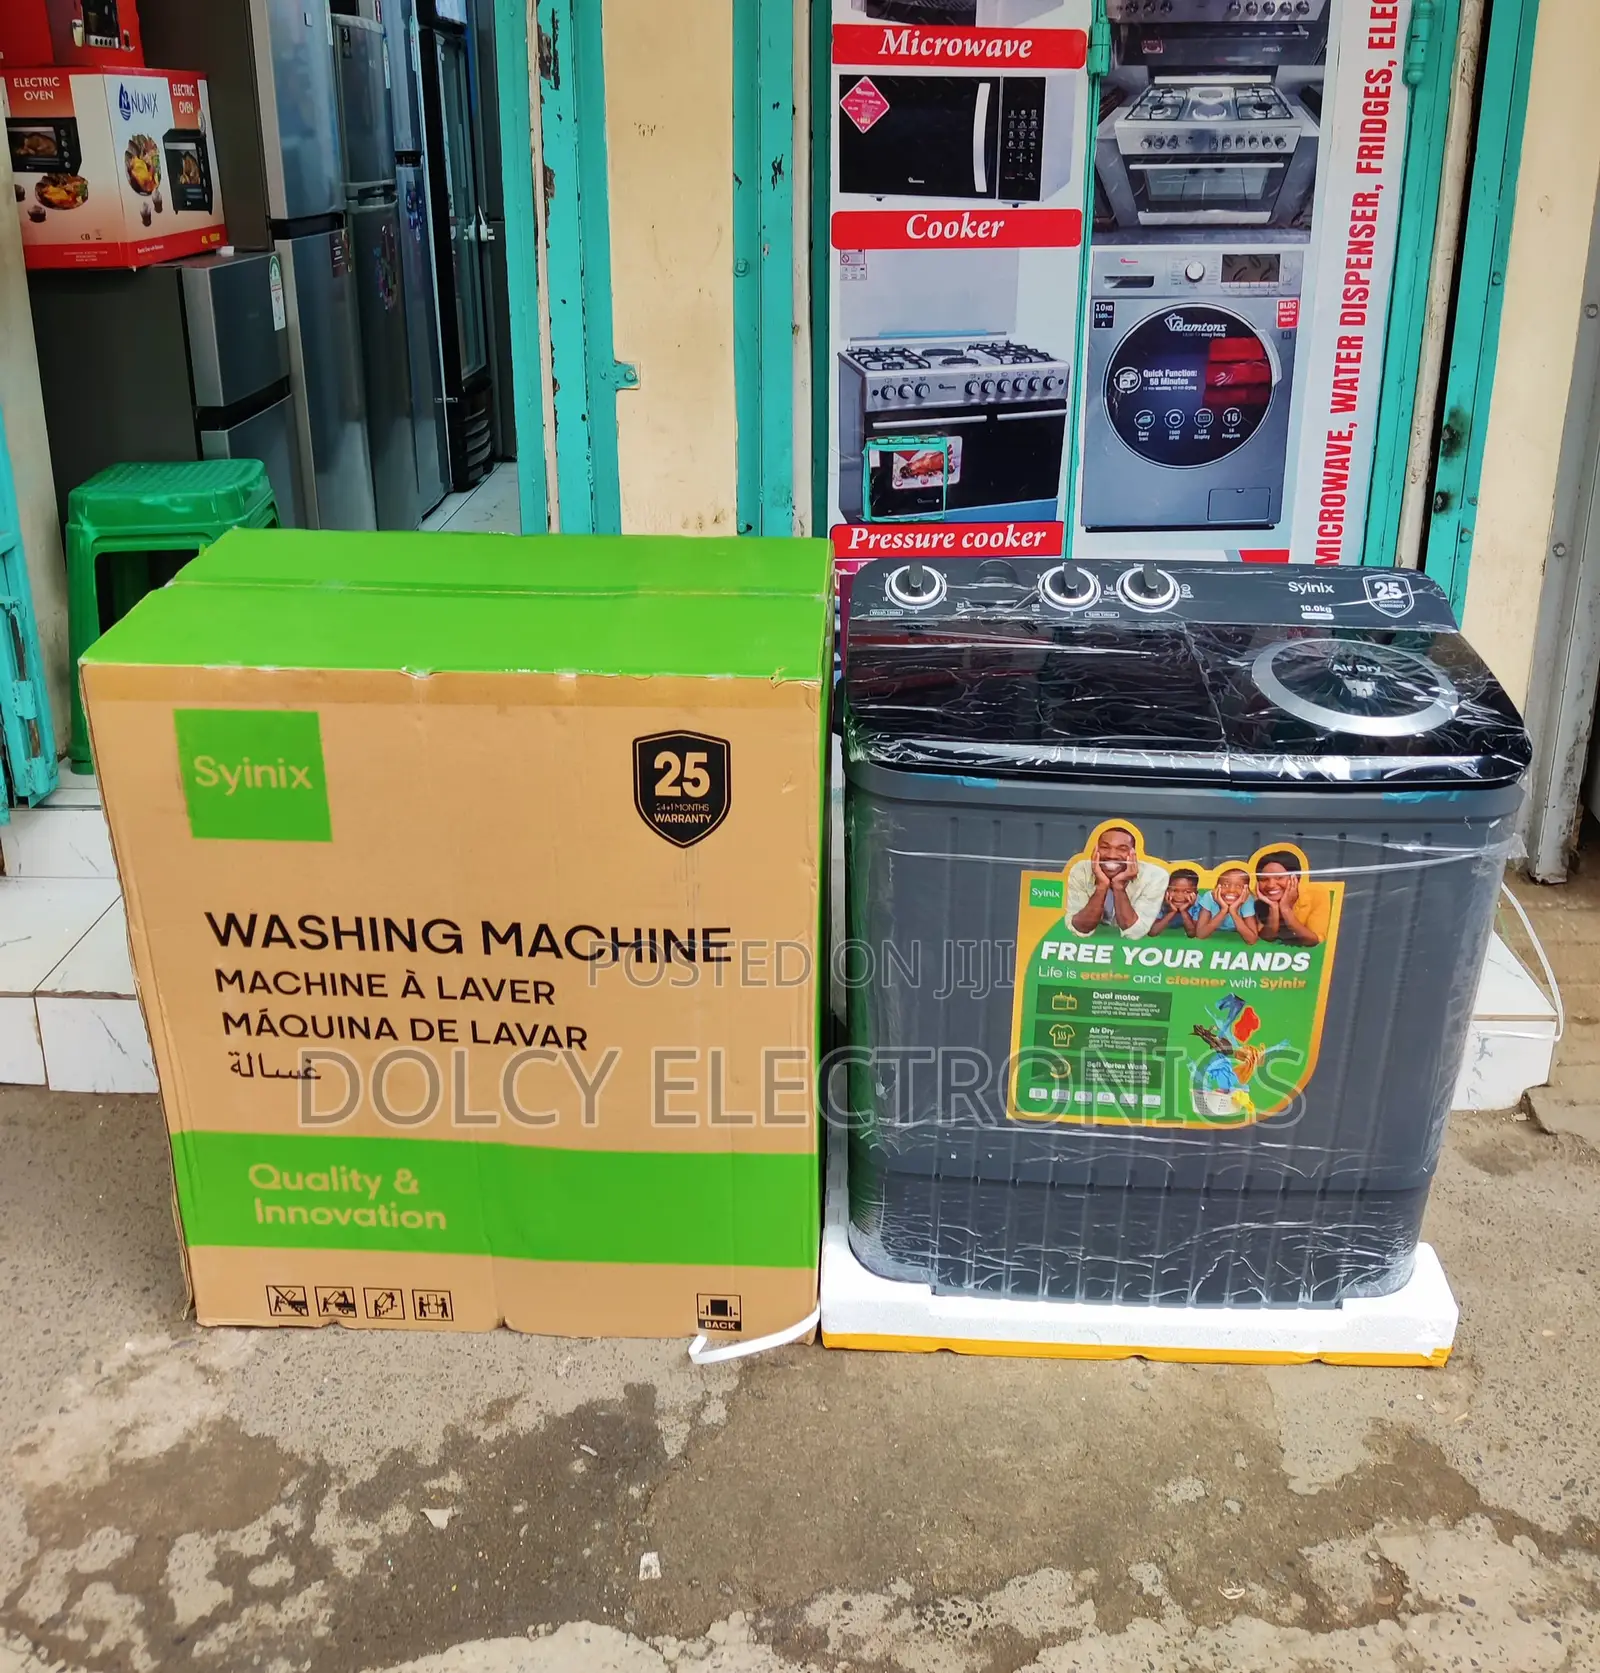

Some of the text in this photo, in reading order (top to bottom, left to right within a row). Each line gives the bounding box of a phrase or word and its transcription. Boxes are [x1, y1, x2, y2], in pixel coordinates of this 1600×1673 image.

[1367, 0, 1398, 49] ELE
[878, 29, 1033, 58] Microwave
[13, 76, 60, 88] ELECTRIC
[172, 84, 195, 96] ELECTRIC
[24, 90, 54, 101] OVEN
[131, 90, 159, 118] NUNIX
[178, 101, 194, 114] OVEN
[1355, 59, 1397, 174] FRIDGES,
[906, 212, 1005, 240] Cooker
[1339, 184, 1384, 326] DISPENSER,
[1143, 369, 1163, 378] Quick
[1330, 336, 1364, 414] WATER
[1226, 412, 1238, 422] 16
[1314, 422, 1358, 565] MICROWAVE,
[848, 524, 1046, 549] Pressure cooker
[1288, 581, 1335, 594] Syinix
[1374, 582, 1402, 599] 25
[1300, 604, 1333, 613] 10.0kg
[1356, 665, 1381, 675] Dry
[193, 755, 313, 796] Syinix
[653, 751, 711, 798] 25
[653, 813, 712, 824] WARRANTY
[675, 803, 710, 812] MONTHS
[1032, 888, 1060, 898] Syinix
[204, 912, 733, 964] WASHING MACHINE
[1041, 941, 1310, 973] FREE YOUR HANDS
[213, 968, 556, 1006] MACHINE À LAVER
[1038, 965, 1306, 991] Life is easier and cleaner with Syinix
[1092, 991, 1140, 1002] Dual motor
[222, 1007, 588, 1051] MÁQUINA DE LAVAR
[1089, 1026, 1114, 1036] Air Dry
[229, 1050, 322, 1080] غسالة
[248, 1163, 420, 1200] Quality &
[254, 1197, 447, 1230] Innovation
[704, 1320, 736, 1331] BACK
